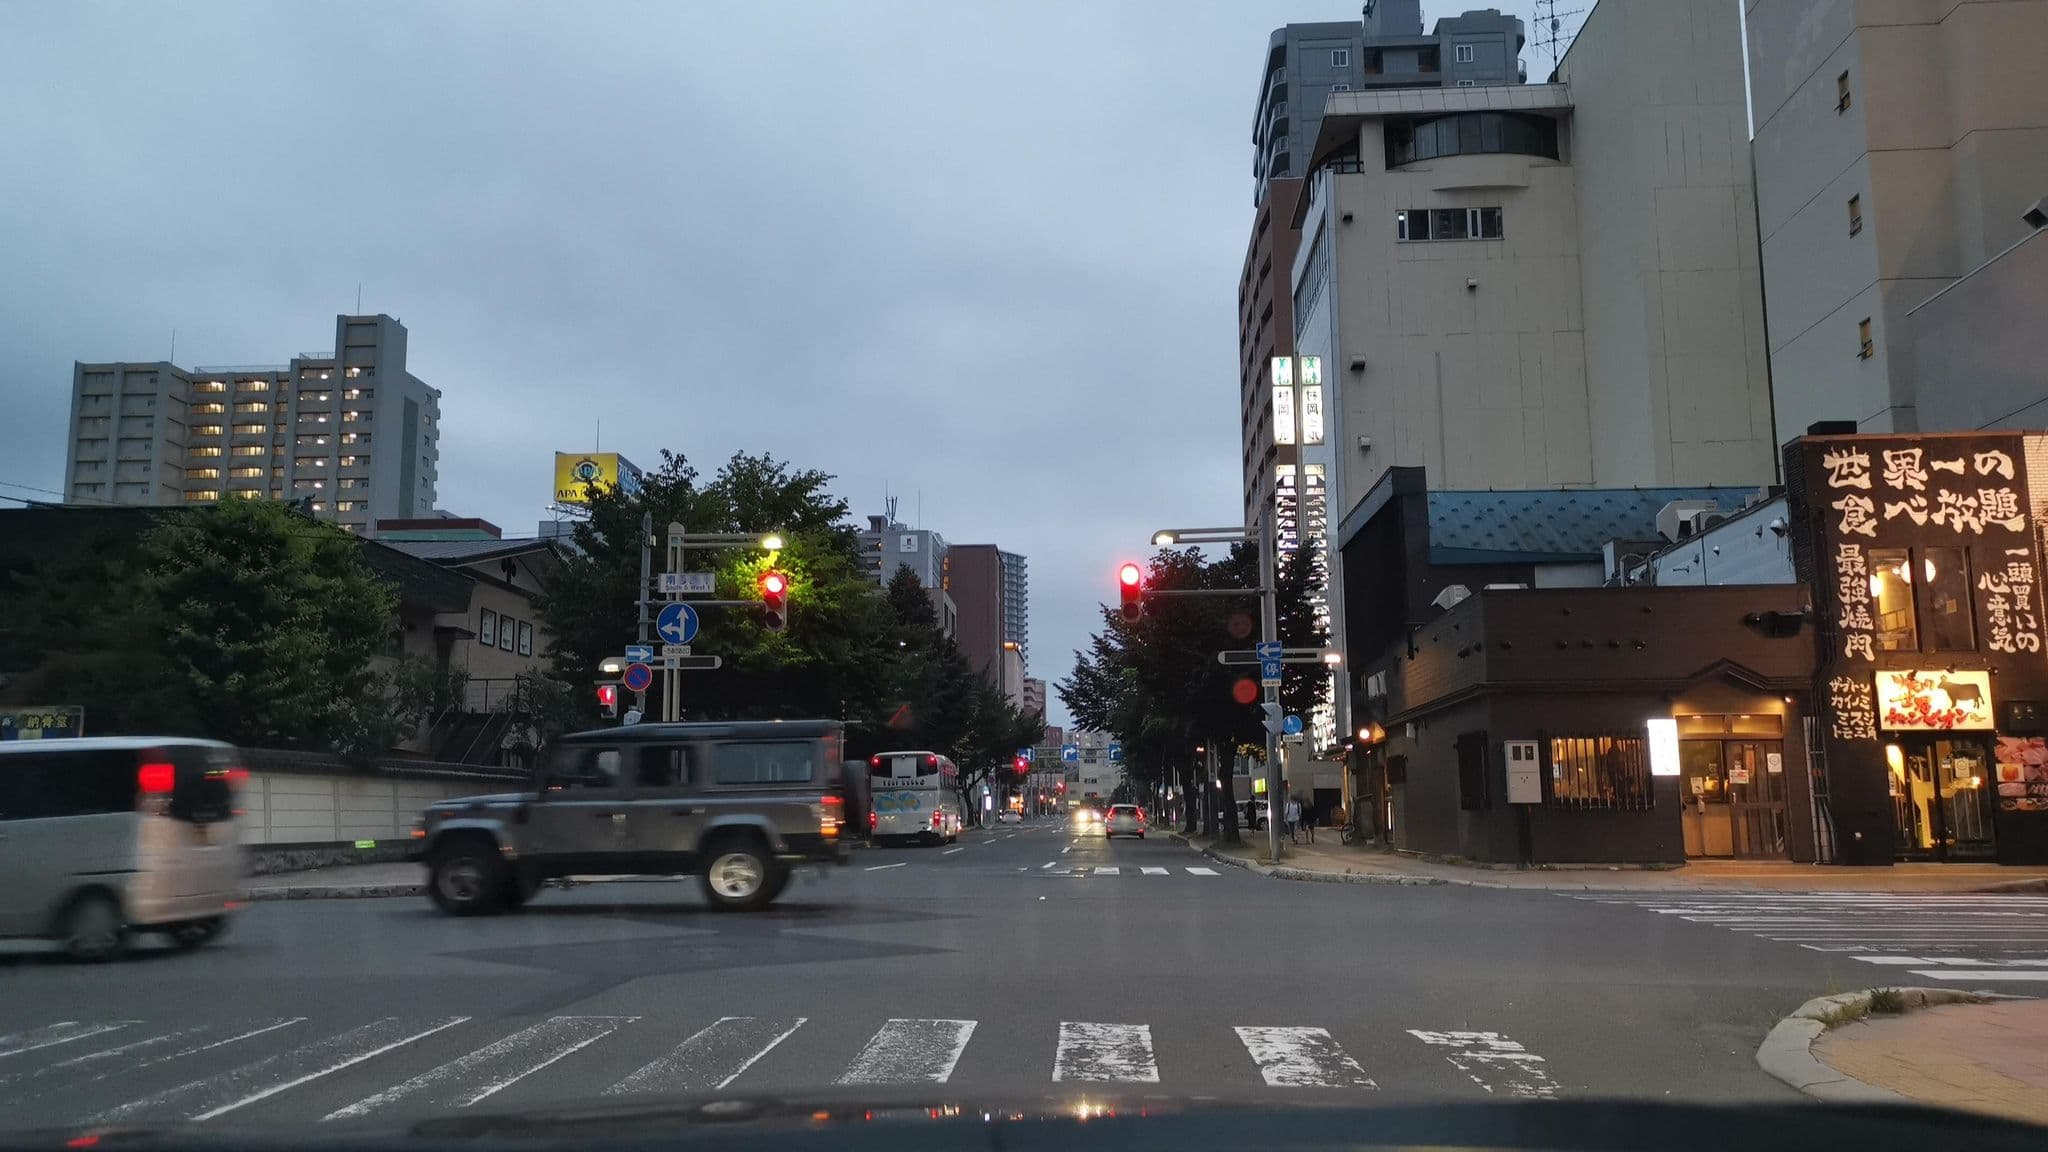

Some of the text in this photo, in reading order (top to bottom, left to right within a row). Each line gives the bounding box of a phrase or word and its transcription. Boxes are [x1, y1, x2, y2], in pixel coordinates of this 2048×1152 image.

[1823, 446, 2014, 491] 世界一の
[557, 489, 577, 498] APA
[1832, 487, 2025, 537] 食べ放題
[1836, 543, 1875, 661] 最強焼肉
[1978, 571, 2016, 653] 心意気
[2005, 547, 2040, 653] 一頭買いの
[1829, 676, 1870, 693] ザブトン
[1831, 694, 1870, 710] カイノミ
[1832, 724, 1877, 740] トモ三角
[1836, 711, 1875, 726] ミスジ
